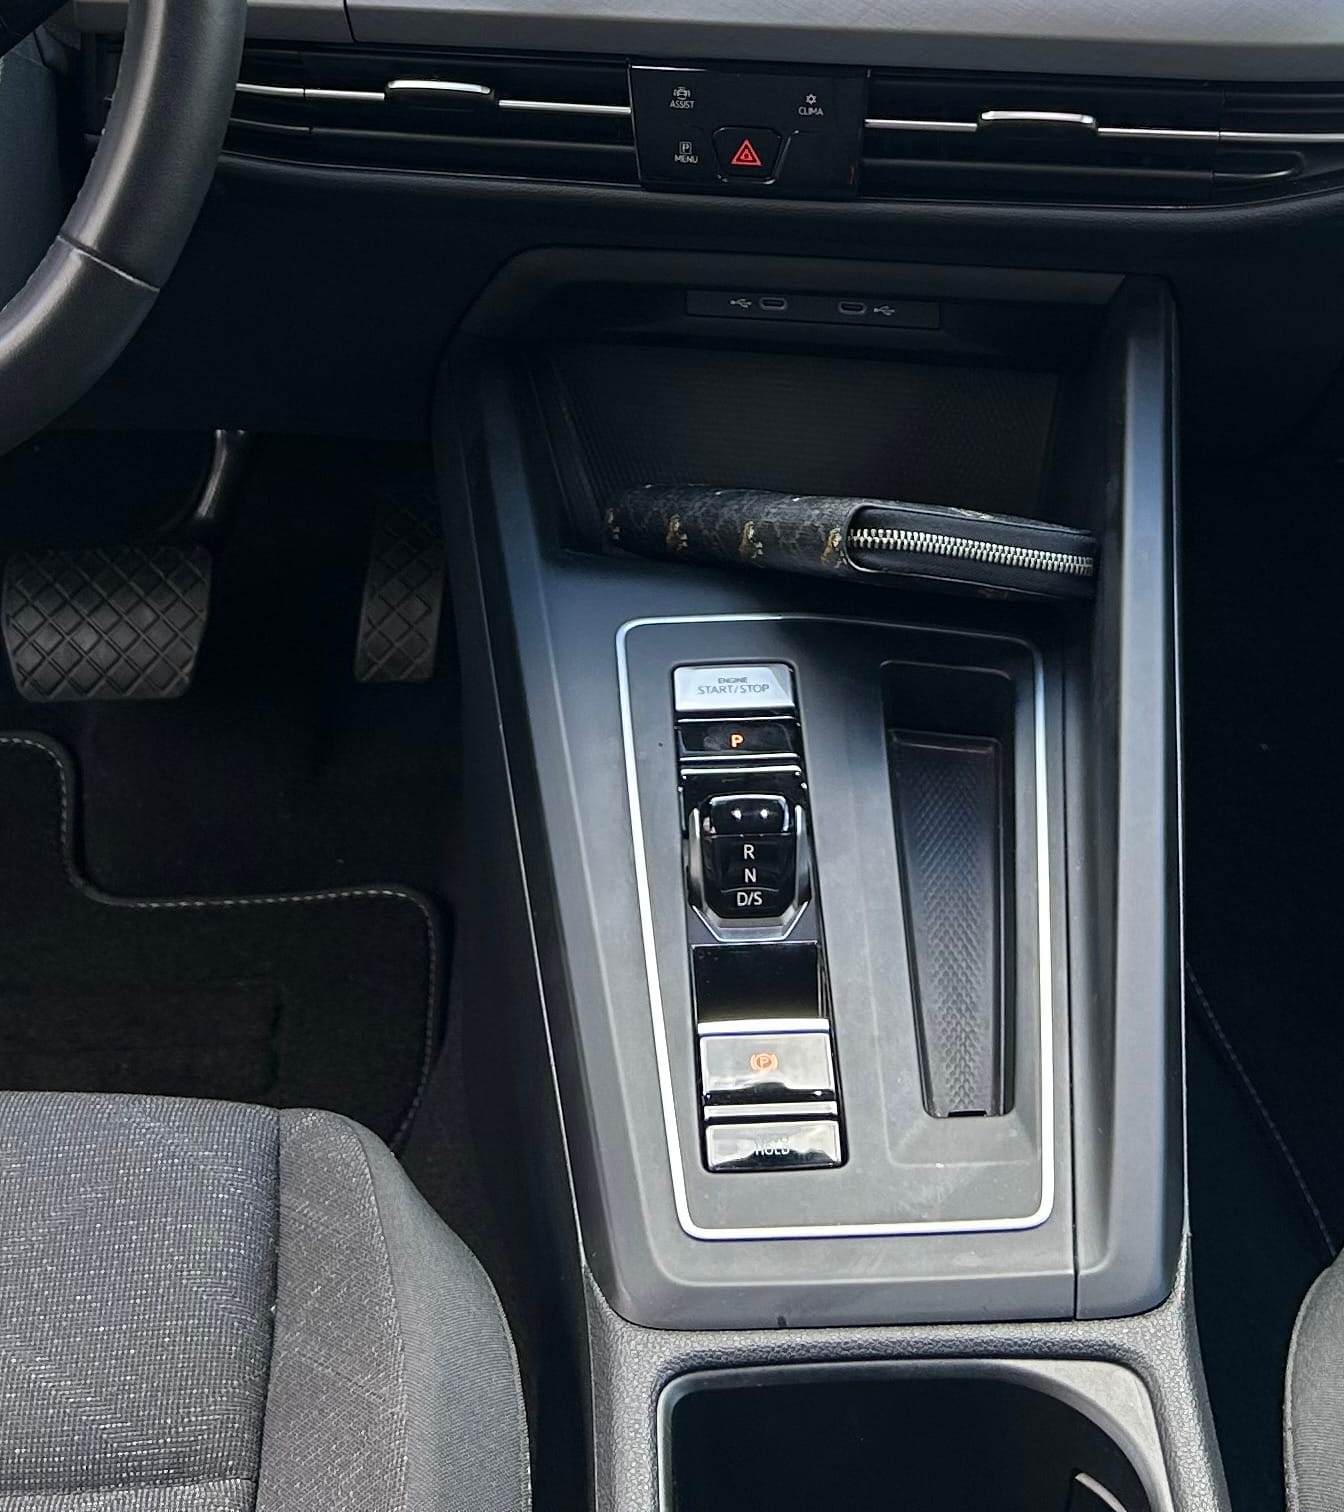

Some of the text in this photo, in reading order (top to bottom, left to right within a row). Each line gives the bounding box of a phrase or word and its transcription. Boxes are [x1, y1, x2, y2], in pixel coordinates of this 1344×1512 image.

[669, 100, 695, 109] ASSIST
[798, 107, 824, 117] CLIMA
[674, 154, 699, 164] MENU
[730, 734, 744, 748] P
[743, 844, 755, 860] R
[744, 868, 756, 884] N
[736, 891, 763, 907] D/S
